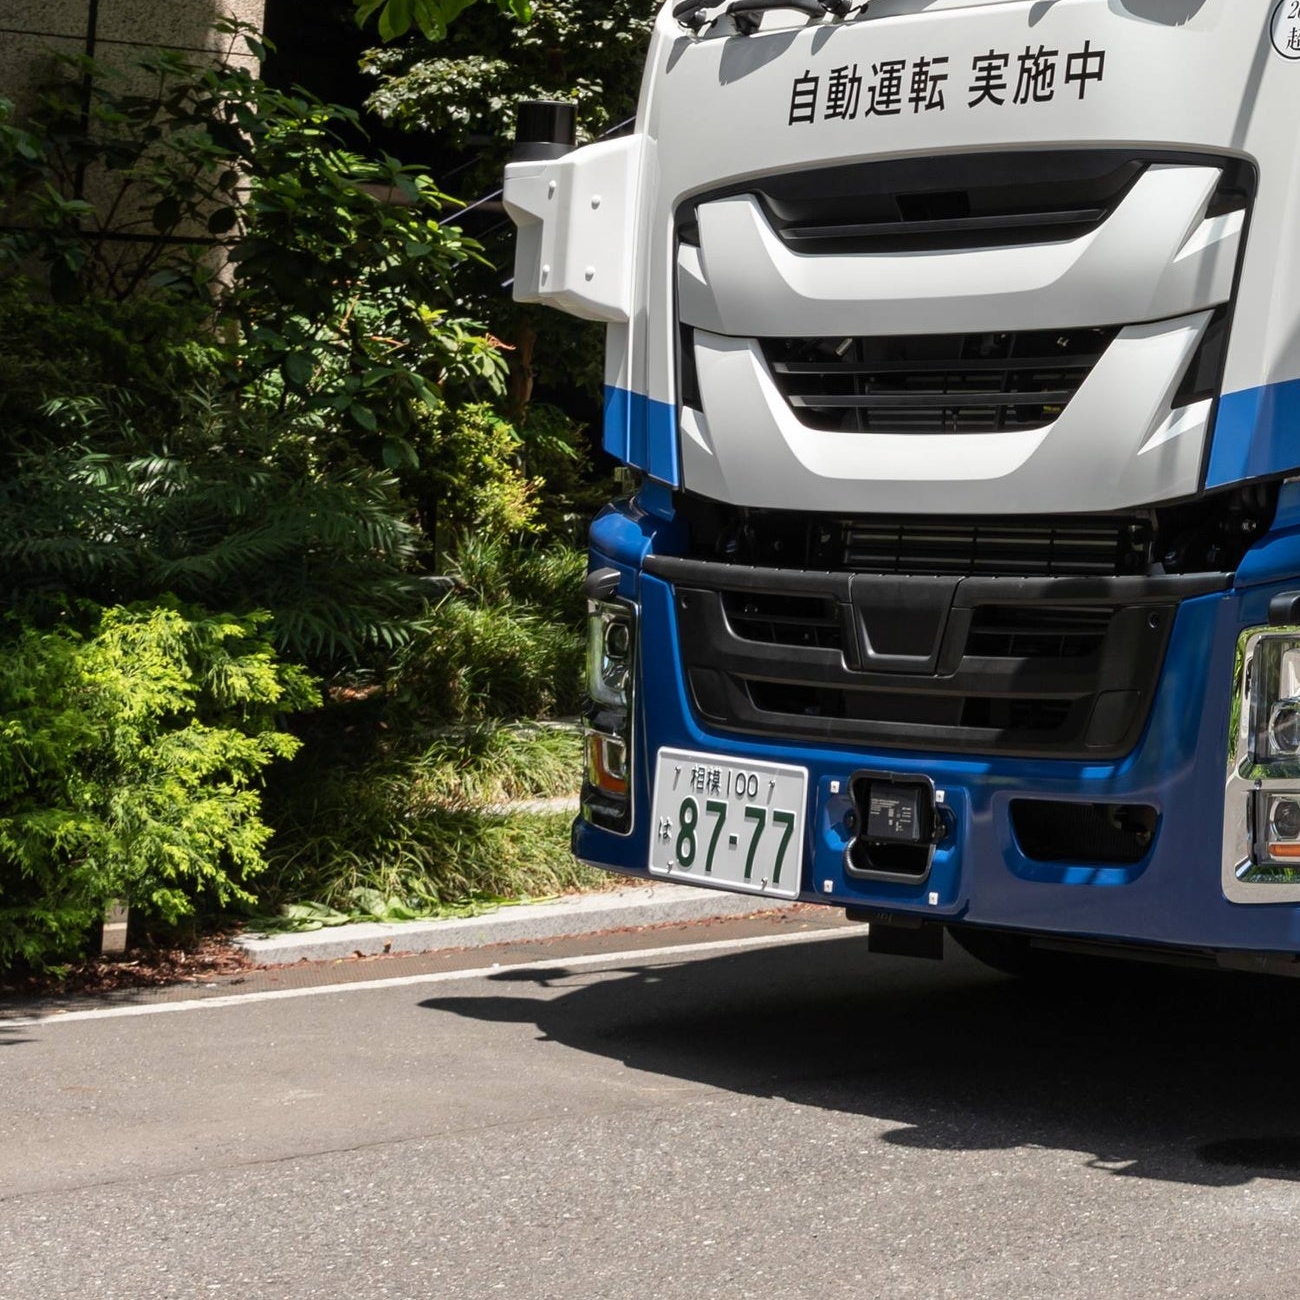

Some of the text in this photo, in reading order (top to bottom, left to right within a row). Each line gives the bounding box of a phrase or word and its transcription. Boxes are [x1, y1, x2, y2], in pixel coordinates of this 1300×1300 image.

[788, 38, 1107, 126] 自動運転 実施中
[690, 764, 759, 798] 相模 100
[658, 796, 796, 884] は 87-77
